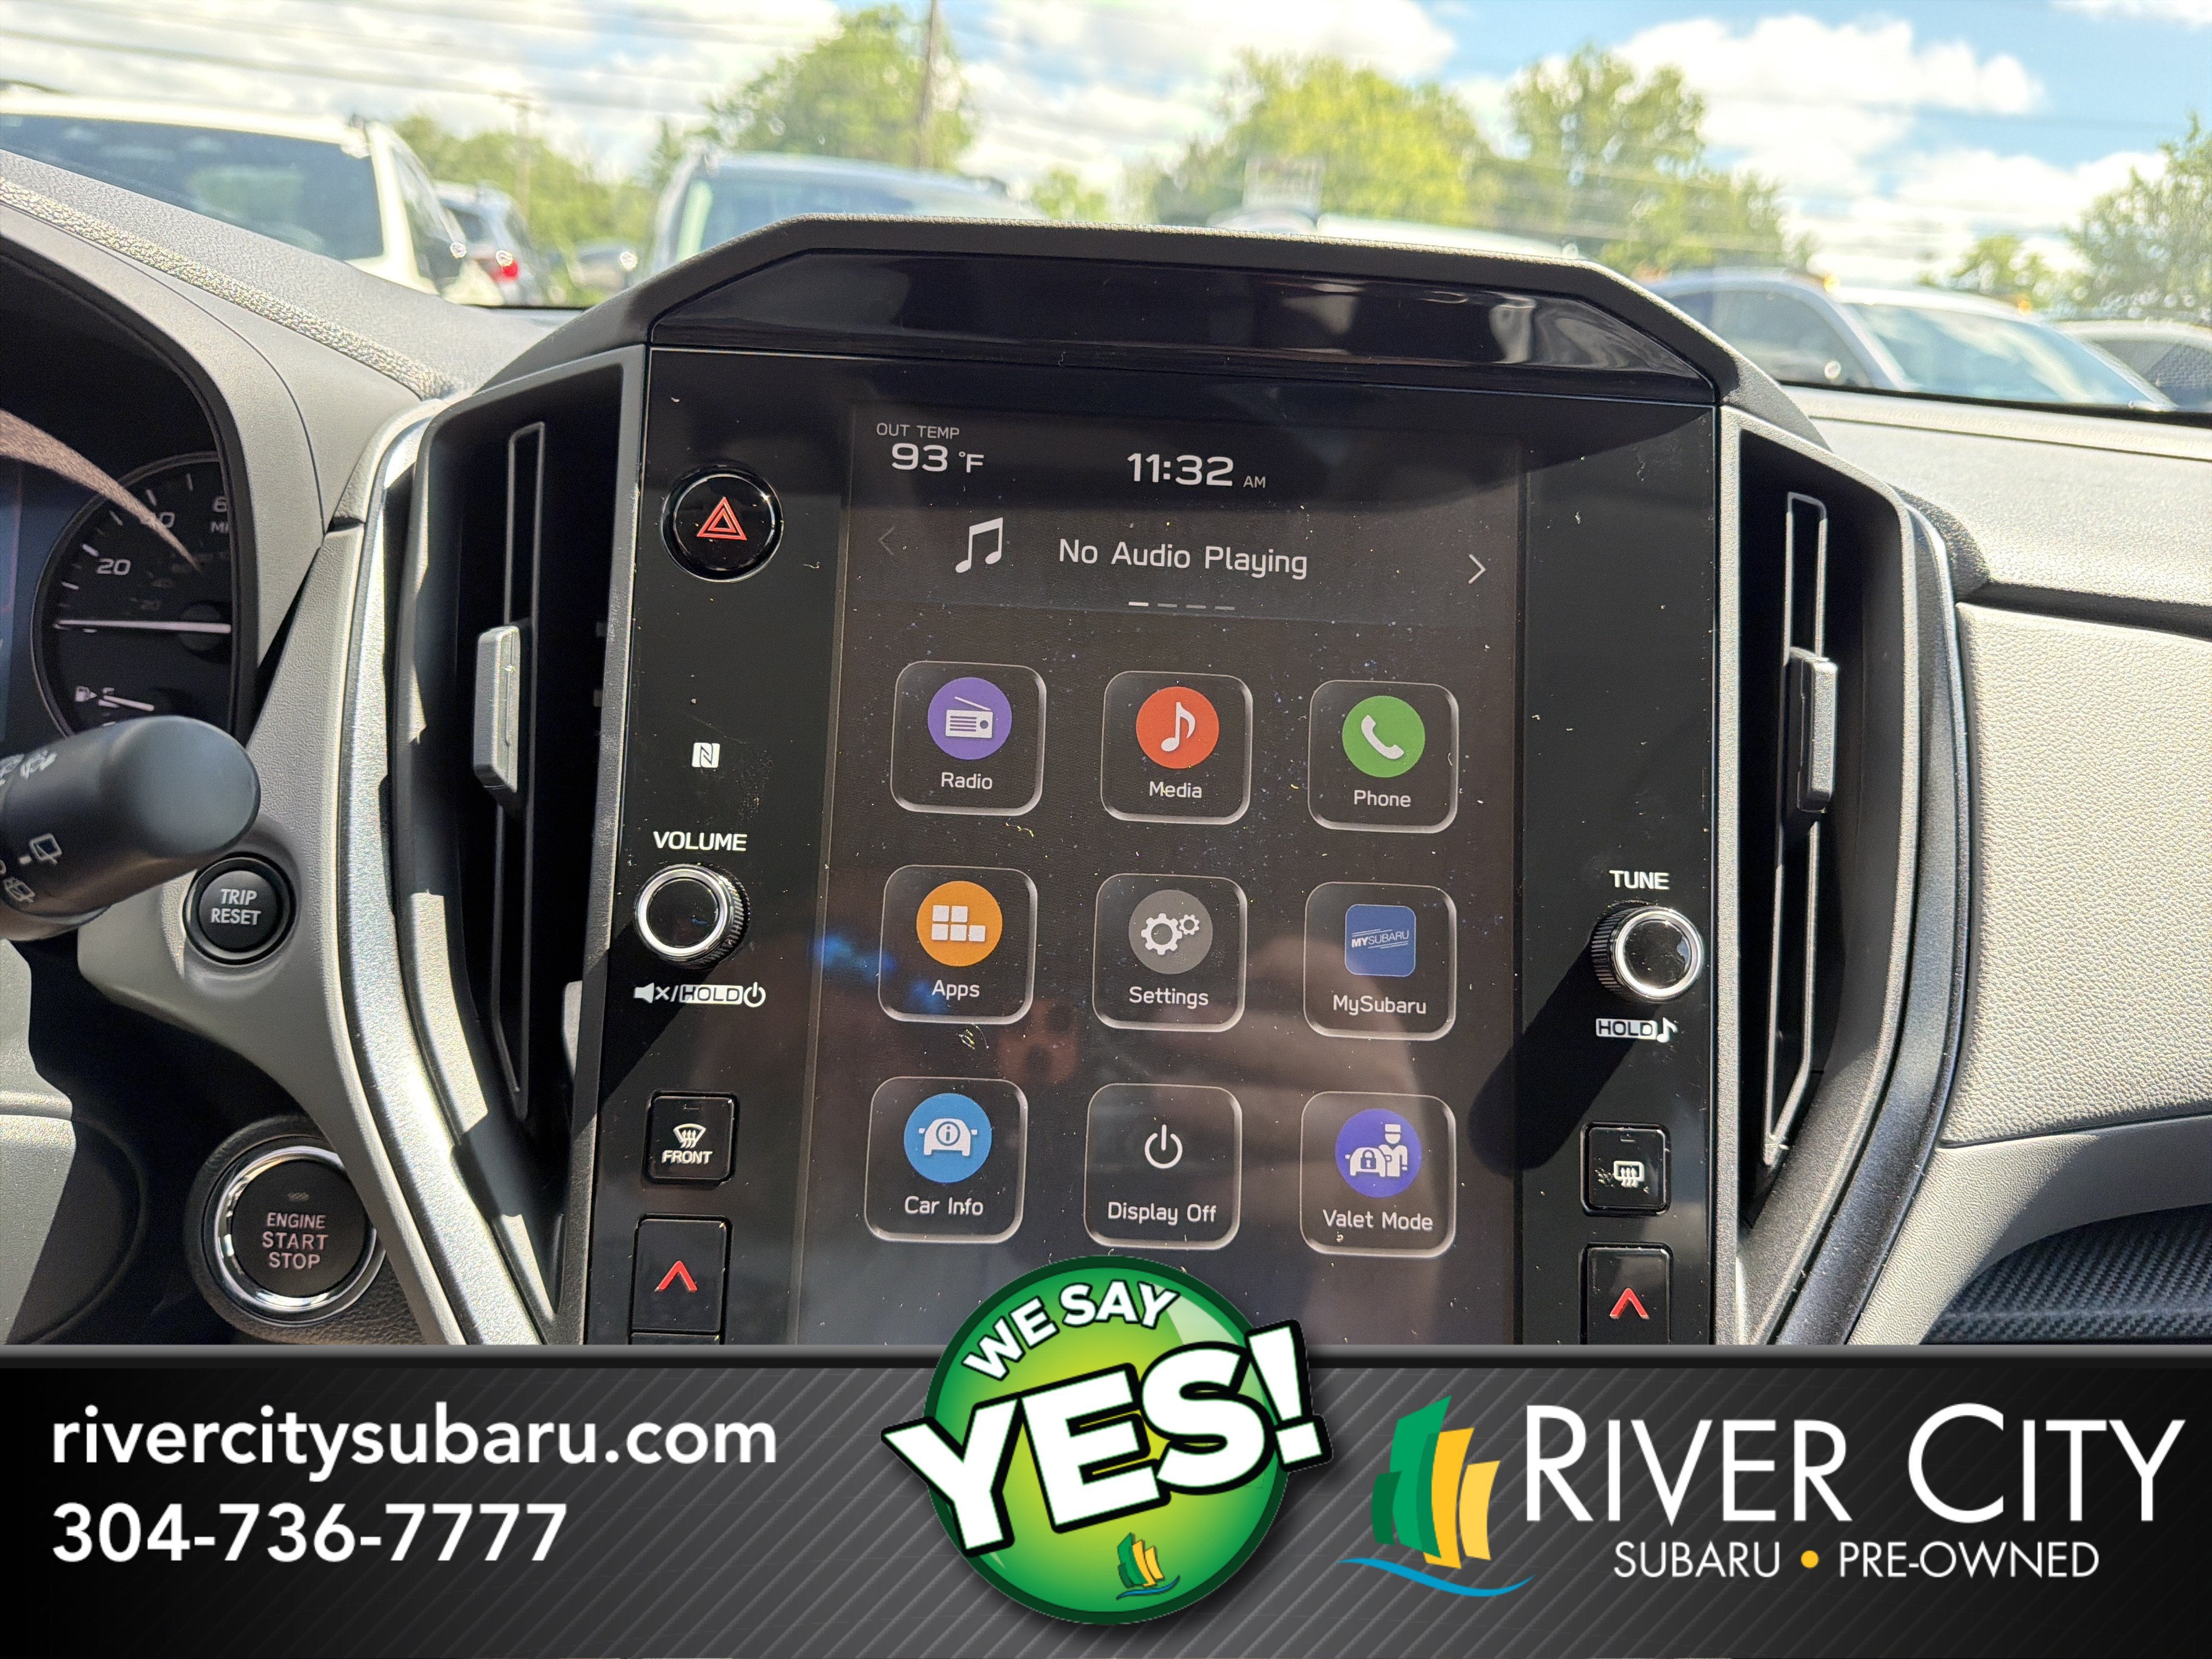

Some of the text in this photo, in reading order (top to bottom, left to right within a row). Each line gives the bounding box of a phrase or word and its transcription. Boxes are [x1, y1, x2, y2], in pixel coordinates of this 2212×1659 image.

[876, 422, 960, 439] OUT TEMP
[891, 443, 948, 472] 93
[1127, 453, 1266, 488] 11:32 AM
[96, 558, 131, 575] 20
[1059, 538, 1307, 580] No Audio Playing
[941, 771, 993, 790] Radio
[1149, 781, 1202, 798] Media
[1354, 789, 1411, 808] Phone
[653, 831, 748, 851] VOLUME
[1609, 870, 1669, 890] TUNE
[219, 888, 257, 905] TRIP
[211, 907, 261, 925] RESET
[1351, 930, 1409, 948] MYSUBARU
[932, 979, 980, 1001] Apps
[1129, 986, 1209, 1009] Settings
[1333, 994, 1426, 1016] MySubaru
[1596, 1019, 1656, 1040] HOLD
[662, 1150, 713, 1164] FRONT
[905, 1195, 984, 1216] Car Info
[1108, 1201, 1217, 1226] Display Off
[266, 1212, 326, 1229] ENGINE
[1322, 1209, 1434, 1231] Valet Mode
[262, 1231, 329, 1250] START
[269, 1251, 320, 1269] STOP
